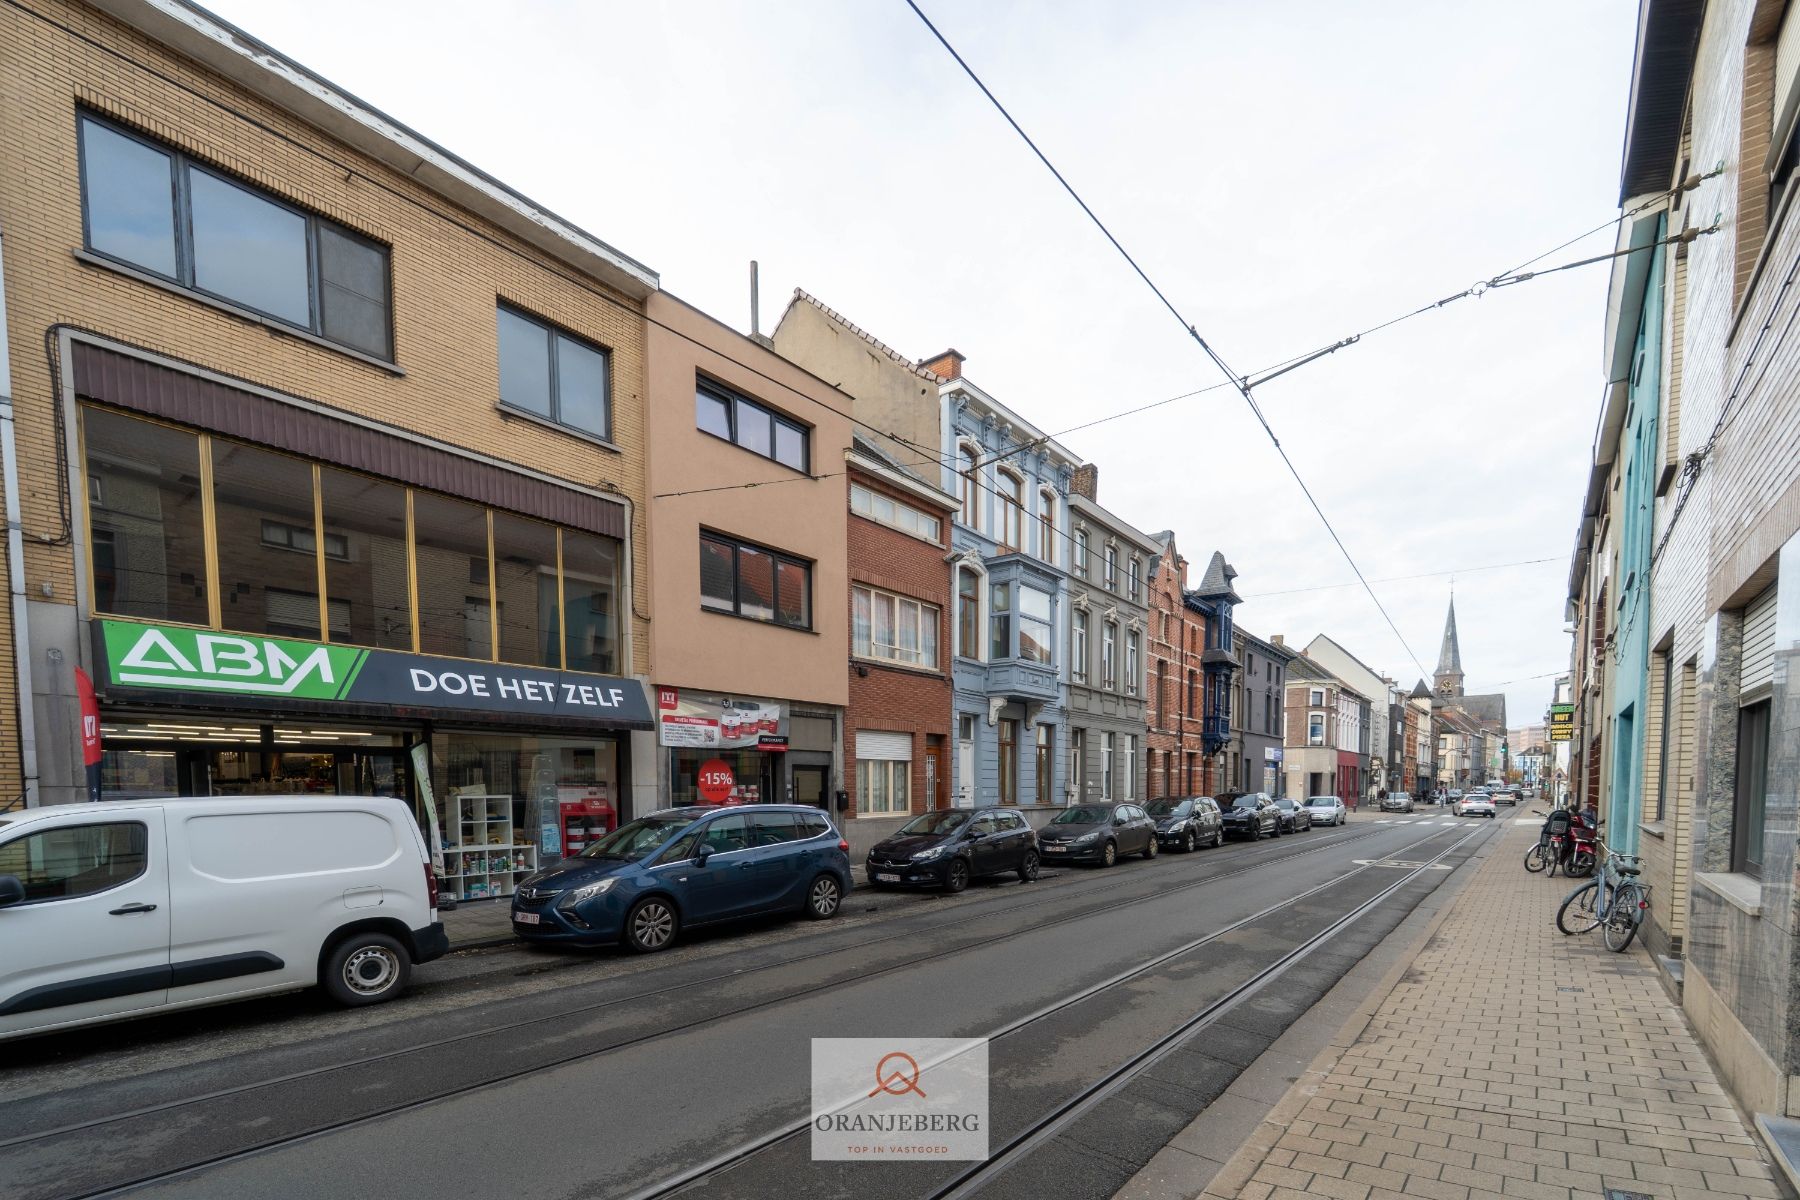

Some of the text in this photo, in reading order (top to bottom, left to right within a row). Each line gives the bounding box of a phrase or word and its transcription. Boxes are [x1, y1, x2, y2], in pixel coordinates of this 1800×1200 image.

[120, 629, 334, 692] ABM
[409, 668, 624, 709] DOE HET ZELF
[1554, 713, 1569, 721] HUT
[700, 772, 733, 785] -15%
